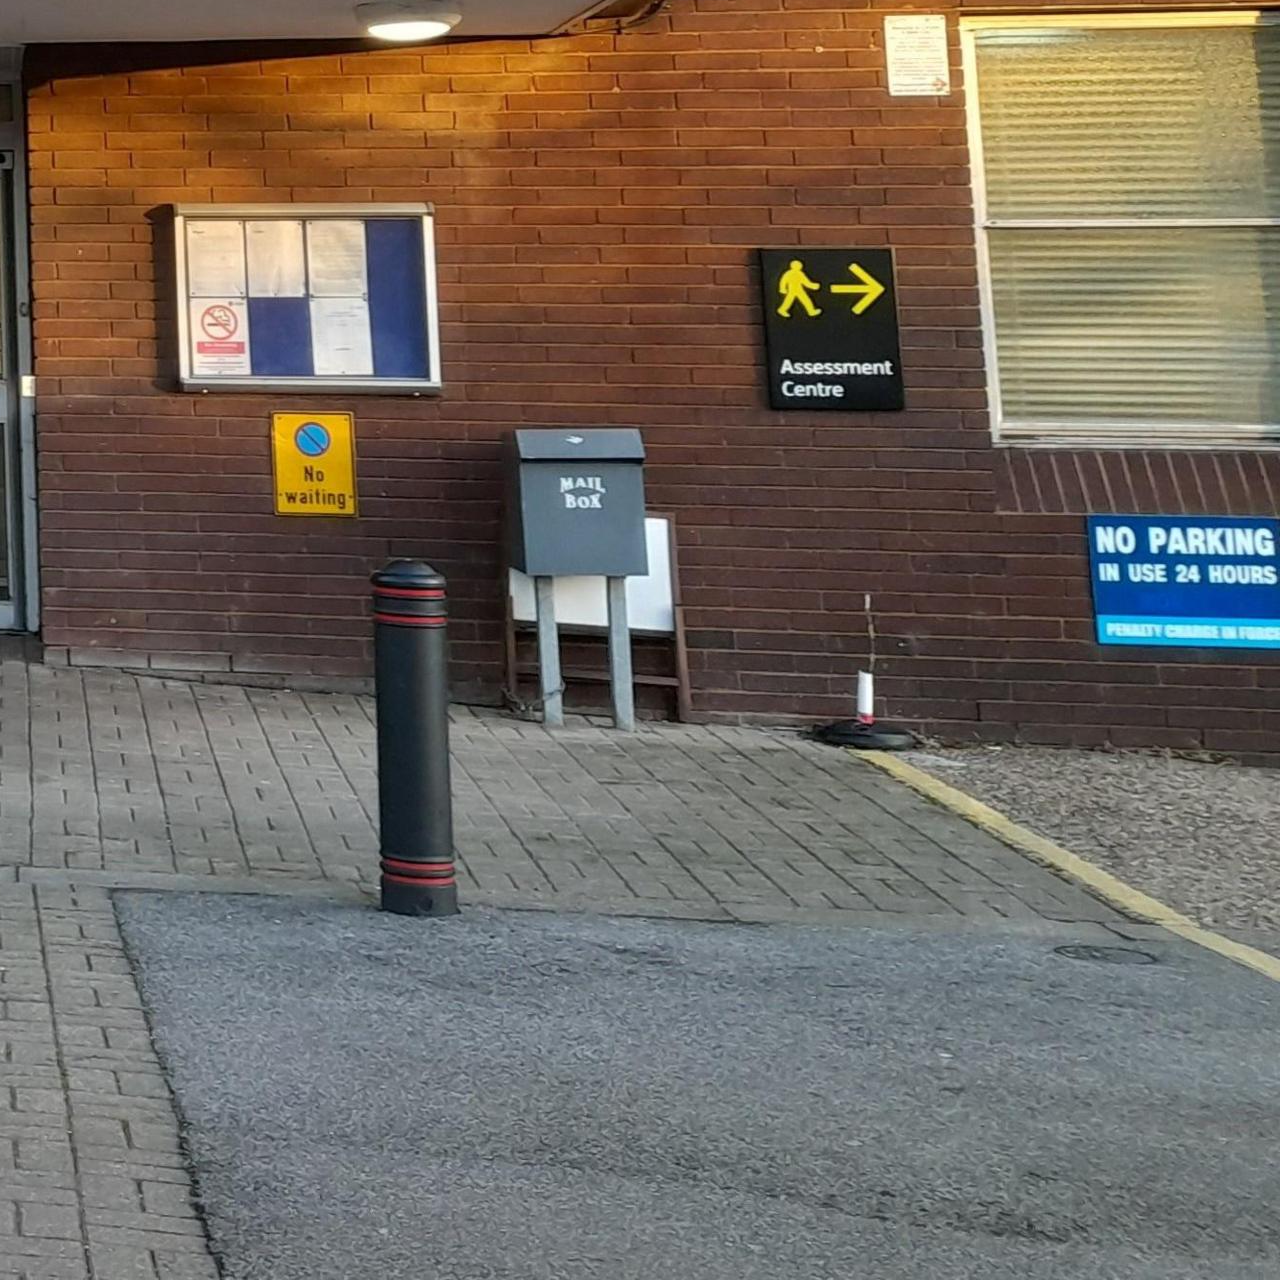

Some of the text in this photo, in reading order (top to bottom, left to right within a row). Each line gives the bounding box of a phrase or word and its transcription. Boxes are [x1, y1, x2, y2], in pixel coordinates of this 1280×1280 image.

[780, 359, 894, 376] Assessment
[781, 381, 845, 398] Centre
[304, 465, 325, 483] No
[560, 477, 606, 494] MAIL
[285, 488, 346, 510] waiting
[1095, 526, 1276, 556] NO PARKING
[1098, 563, 1278, 585] IN USE 24 HOURS
[1106, 622, 1163, 638] PENALTY
[1164, 624, 1220, 639] CHARGE
[1221, 625, 1238, 640] IN
